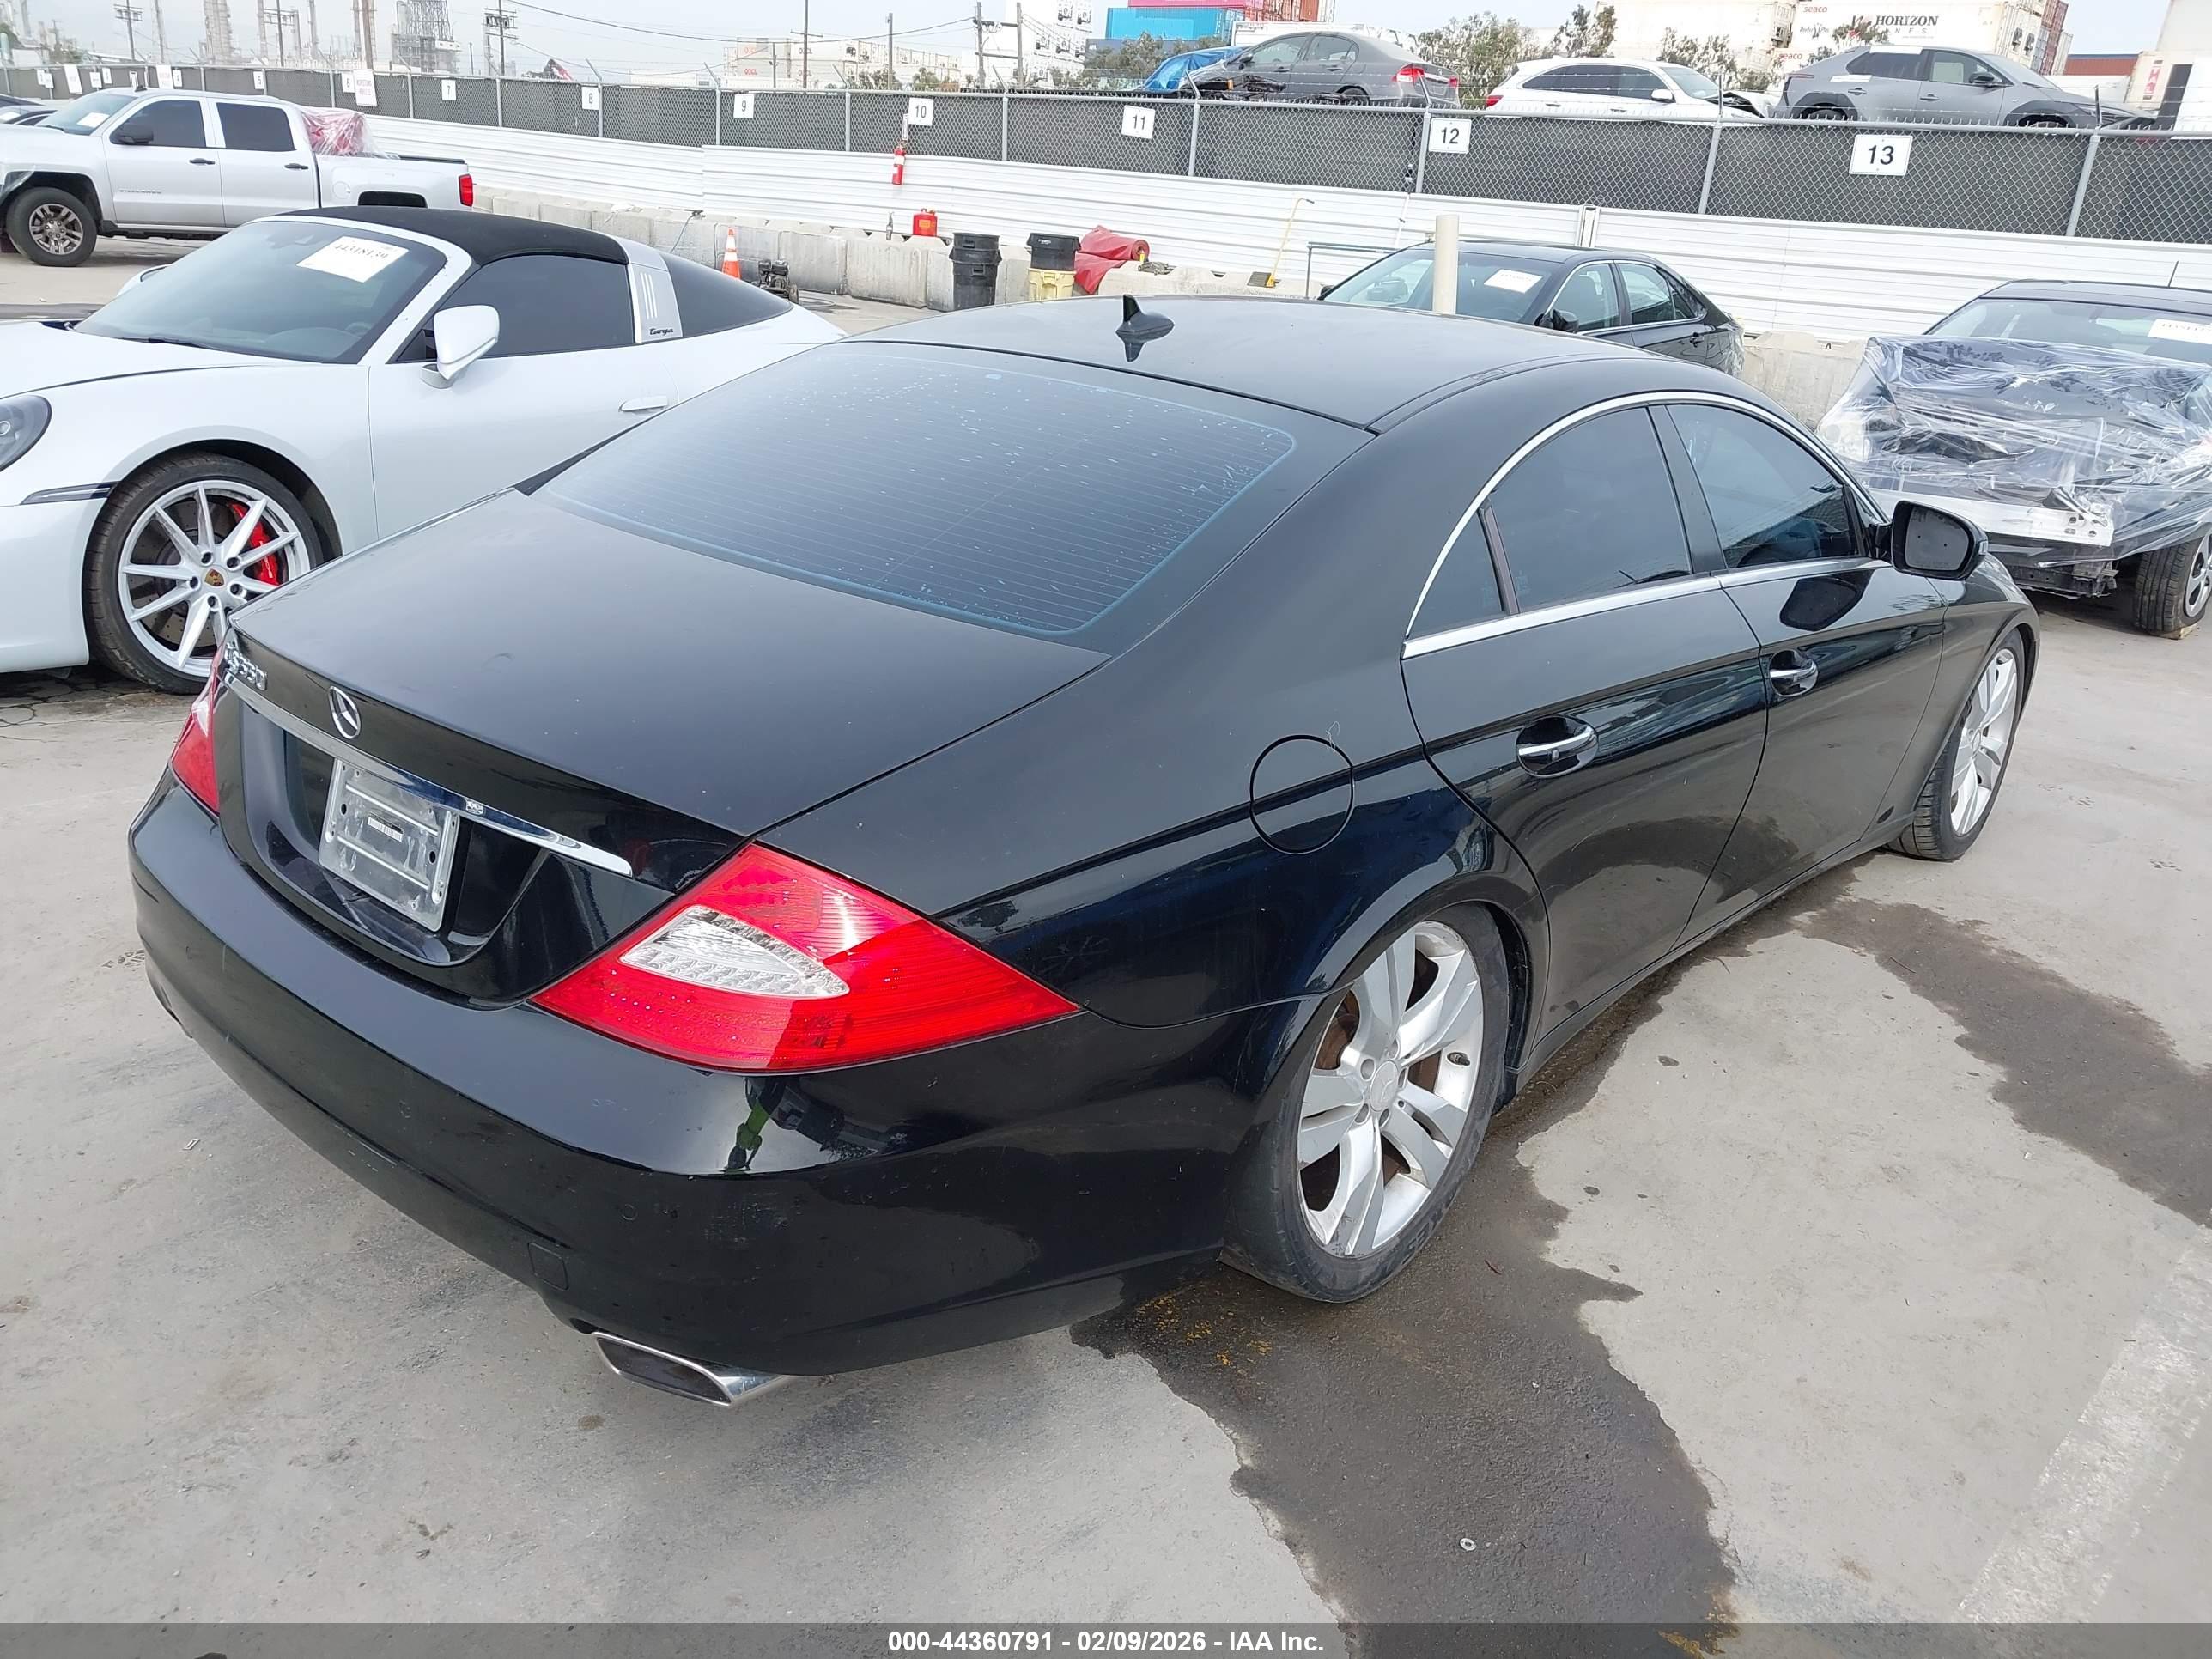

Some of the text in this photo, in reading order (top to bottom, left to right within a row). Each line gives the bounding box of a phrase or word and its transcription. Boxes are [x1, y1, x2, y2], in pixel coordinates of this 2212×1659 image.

[1875, 15, 1939, 27] HORIZON
[447, 85, 451, 95] 7
[588, 93, 593, 104] 8
[741, 100, 747, 112] 9
[915, 105, 927, 118] 10
[1133, 114, 1146, 130] 11
[1441, 127, 1460, 144] 12
[1868, 144, 1894, 165] 13
